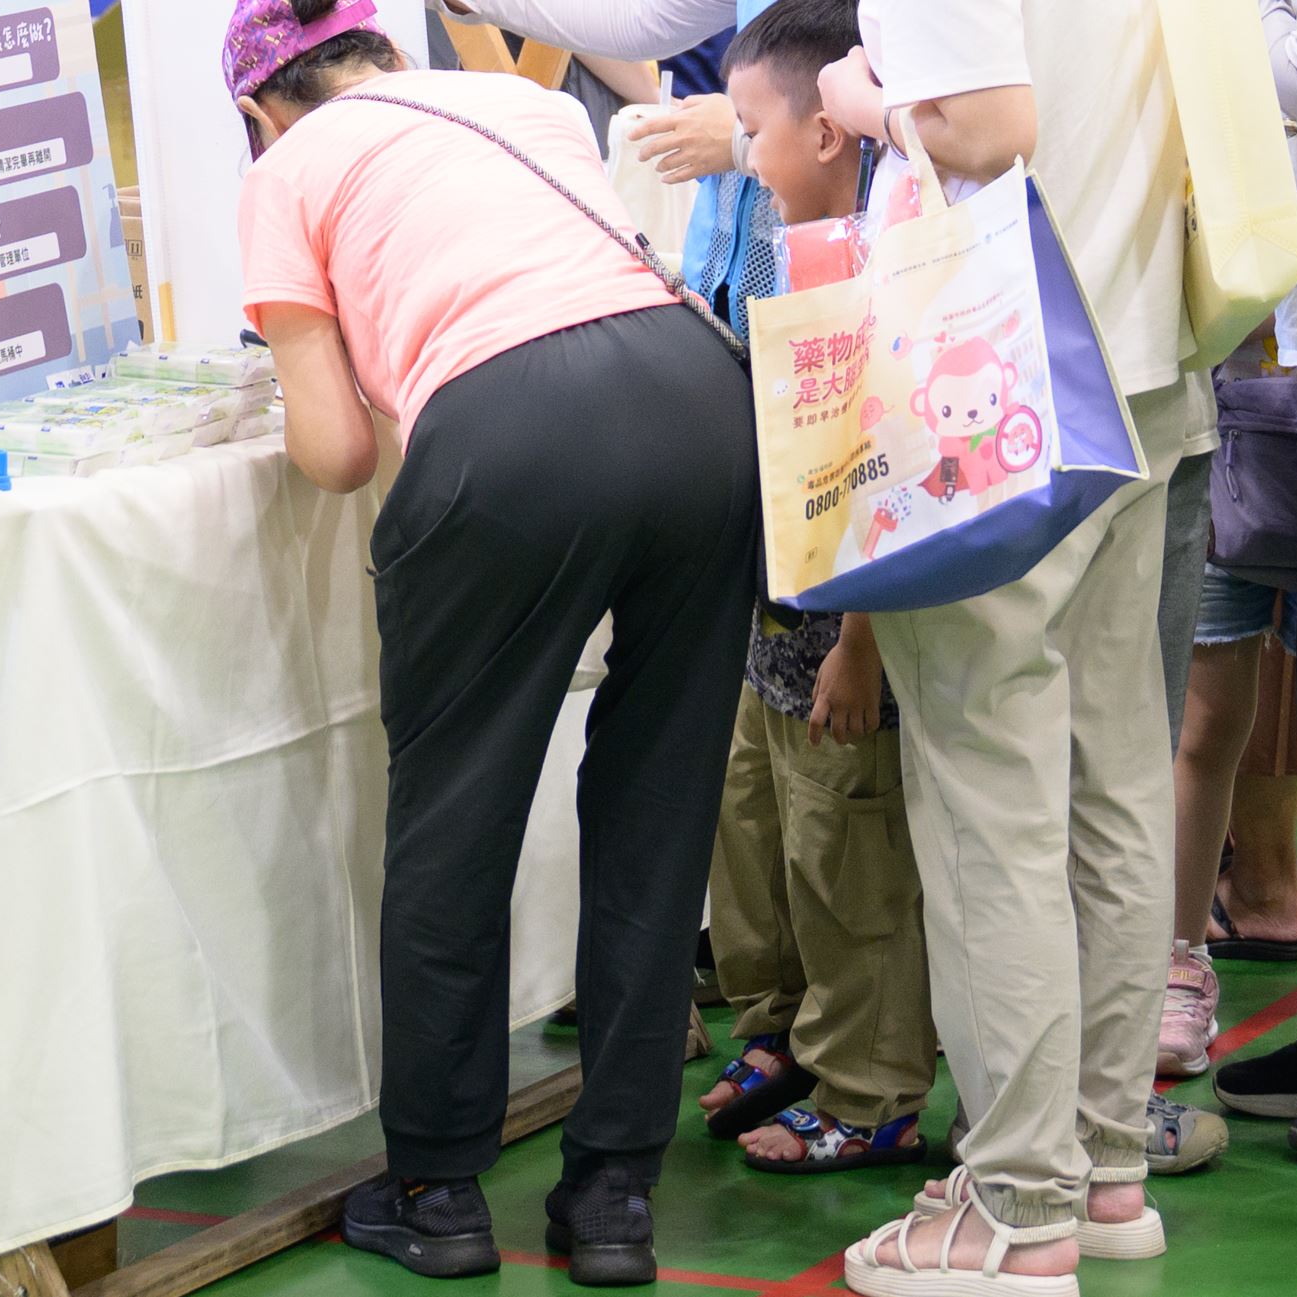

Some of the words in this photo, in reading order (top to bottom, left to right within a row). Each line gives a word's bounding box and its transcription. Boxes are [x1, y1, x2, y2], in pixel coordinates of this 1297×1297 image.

[789, 298, 877, 375] 藥物成
[805, 452, 890, 521] 0800-770885
